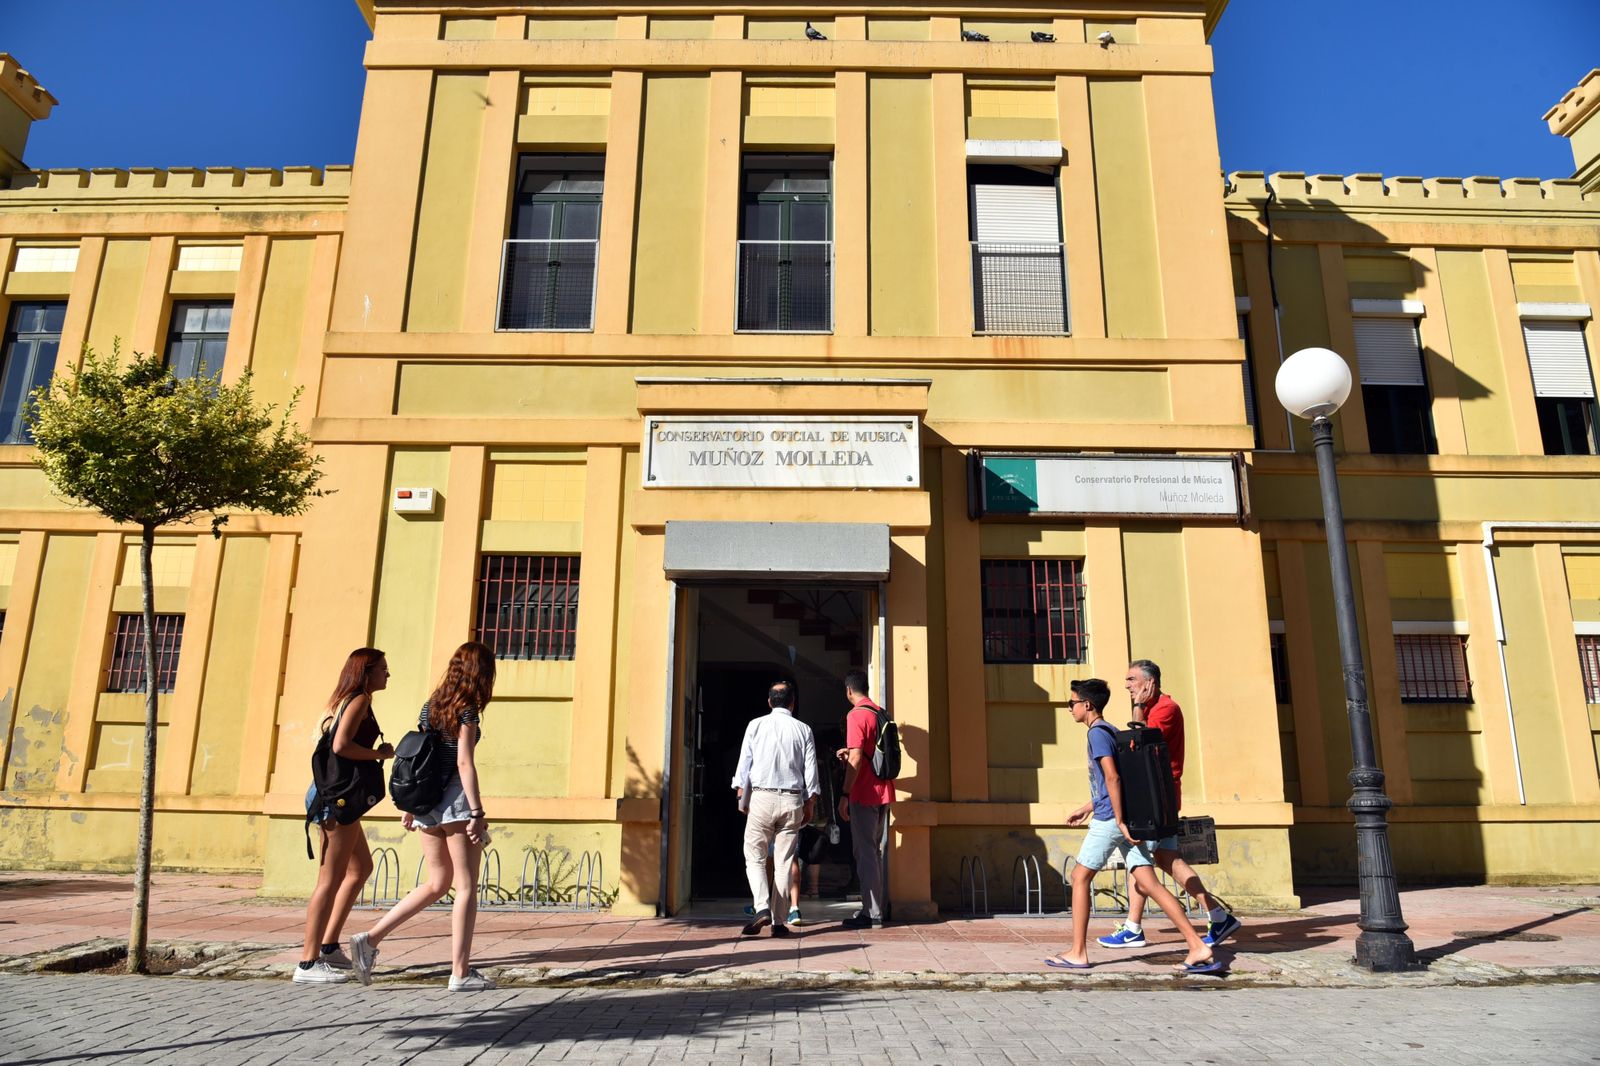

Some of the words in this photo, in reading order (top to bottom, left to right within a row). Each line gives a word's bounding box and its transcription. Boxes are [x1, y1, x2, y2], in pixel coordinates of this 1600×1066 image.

[657, 430, 765, 442] CONSERVATORIO
[770, 430, 825, 442] OFICIAL
[830, 431, 849, 442] DE
[854, 431, 908, 442] MUSICA
[688, 447, 764, 466] MUÑOZ
[775, 450, 874, 466] MOLLEDA
[1074, 475, 1132, 484] Conservatorio
[1133, 475, 1180, 484] Profesional
[1181, 475, 1192, 484] de
[1193, 475, 1223, 485] Música
[1159, 490, 1188, 503] Muñoz
[1190, 491, 1225, 503] Molleda
